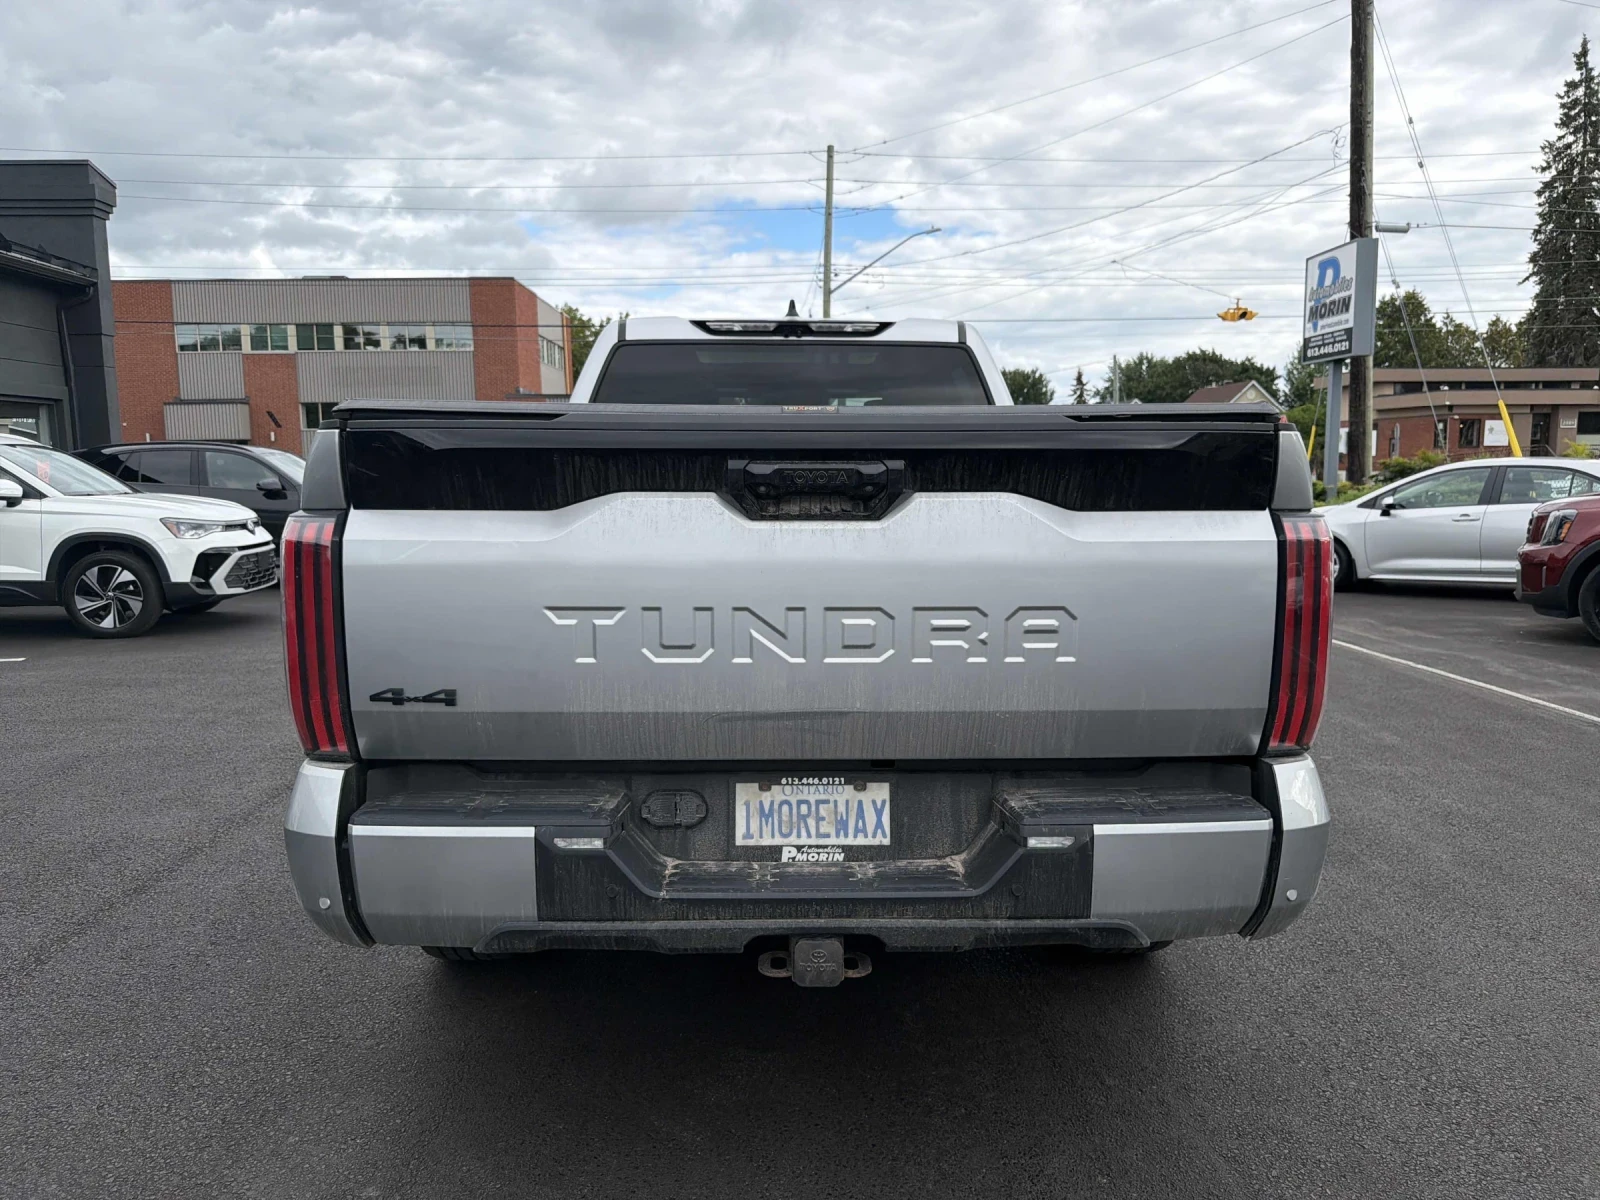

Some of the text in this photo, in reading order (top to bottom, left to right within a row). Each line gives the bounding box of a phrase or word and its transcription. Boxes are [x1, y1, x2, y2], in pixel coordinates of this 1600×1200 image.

[1309, 276, 1353, 302] Automobiles
[1308, 295, 1352, 322] MORIN
[1307, 341, 1349, 357] 613.446.0121
[784, 470, 849, 484] TOYOTA
[543, 606, 1077, 663] TUNDRA
[781, 777, 845, 785] 613.446.0121
[742, 799, 888, 840] 1MOREWAX
[800, 845, 842, 853] Automobiles
[795, 853, 845, 862] MORIN
[800, 962, 837, 971] TOYOTA
